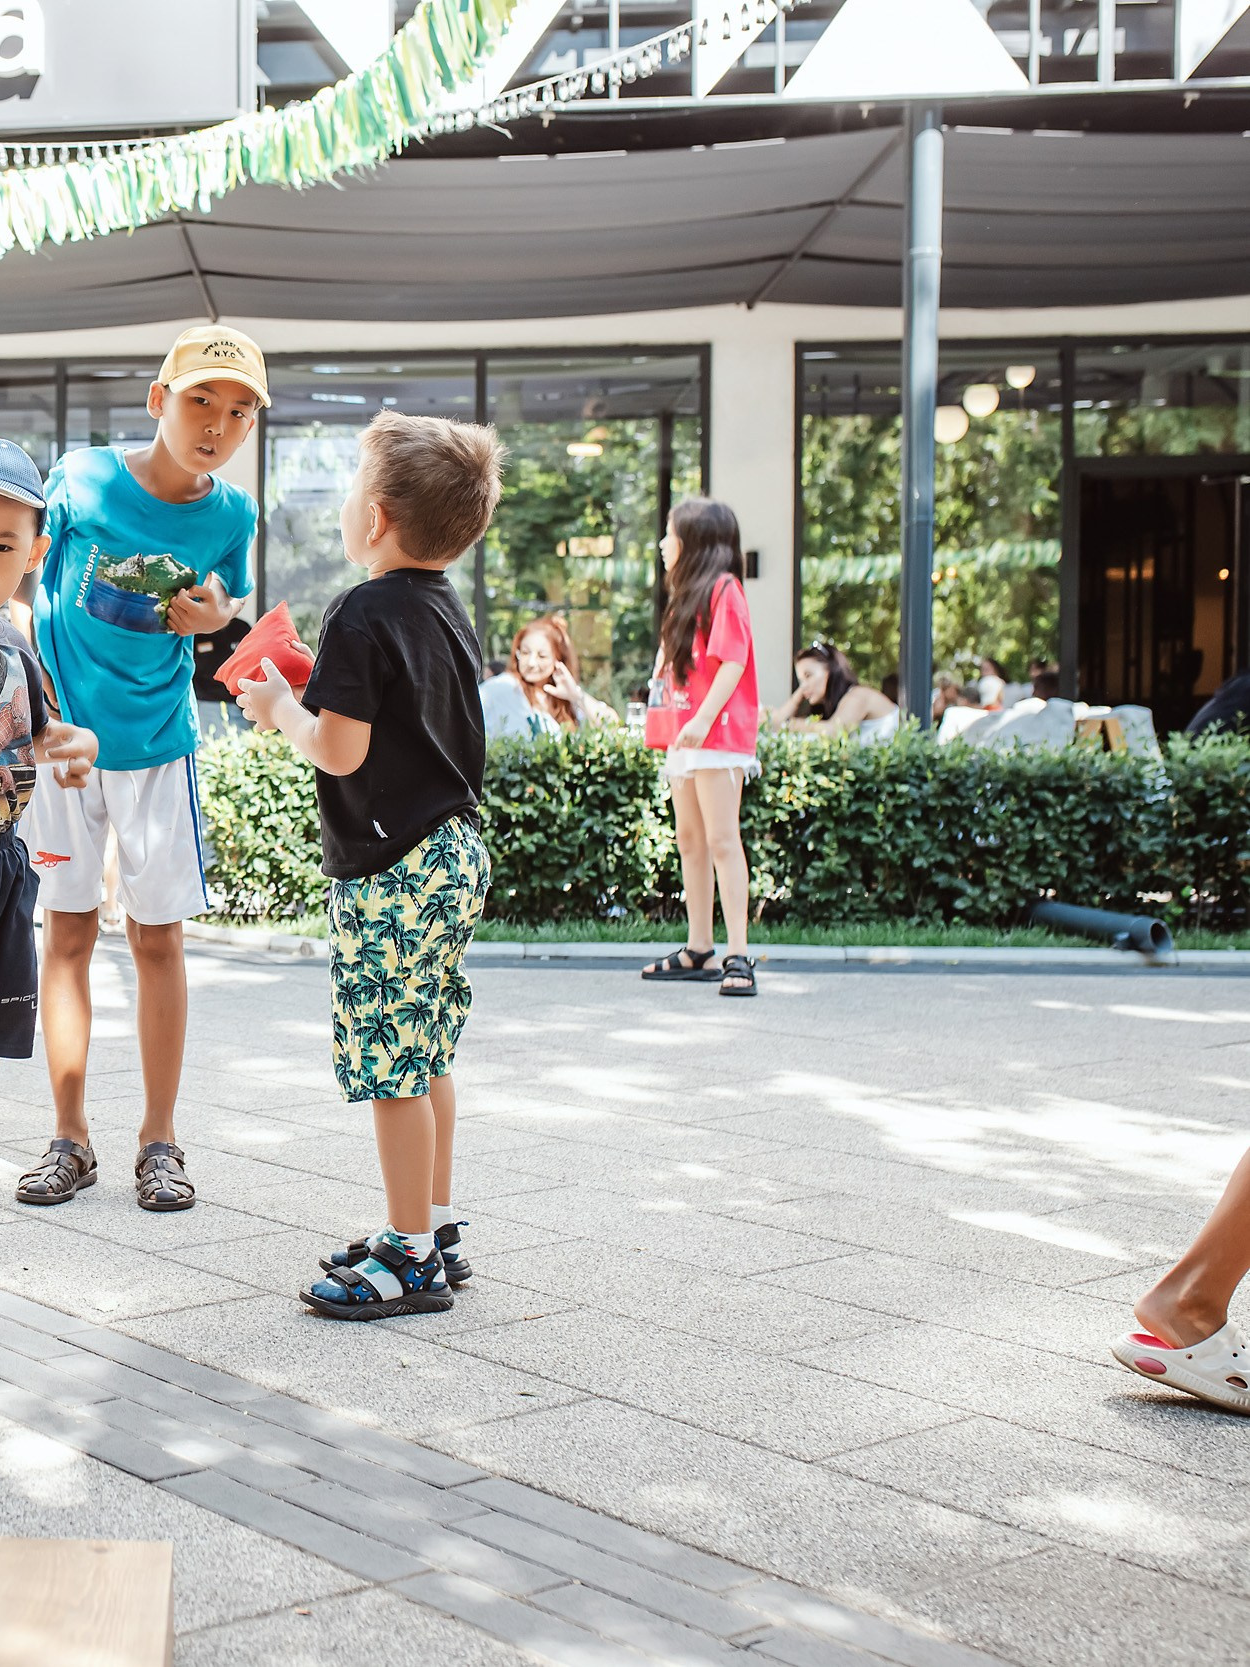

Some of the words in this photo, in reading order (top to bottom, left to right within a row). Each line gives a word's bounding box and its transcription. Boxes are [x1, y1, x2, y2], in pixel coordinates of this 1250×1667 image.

[202, 341, 219, 356] UPPER
[220, 341, 236, 350] EAST
[75, 543, 99, 608] BURABAY
